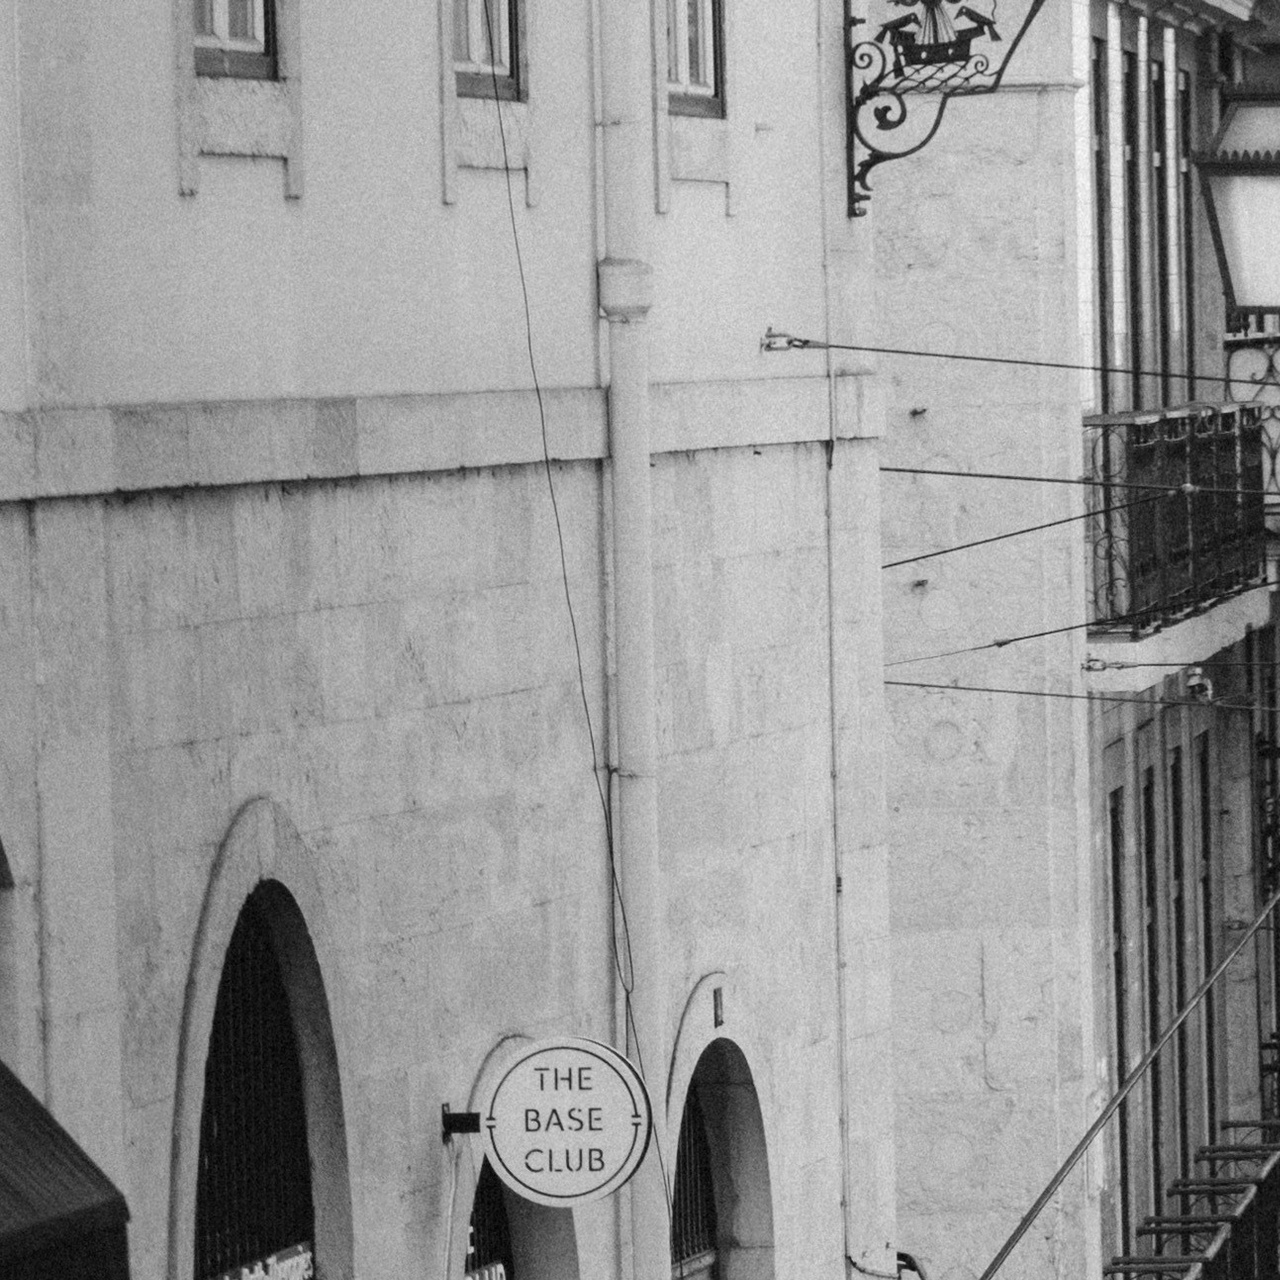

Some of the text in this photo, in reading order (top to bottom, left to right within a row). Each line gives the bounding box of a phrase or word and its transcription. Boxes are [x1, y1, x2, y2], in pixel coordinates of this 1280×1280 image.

[534, 1067, 592, 1091] THE
[525, 1108, 603, 1132] BASE
[525, 1148, 605, 1172] CLUB
